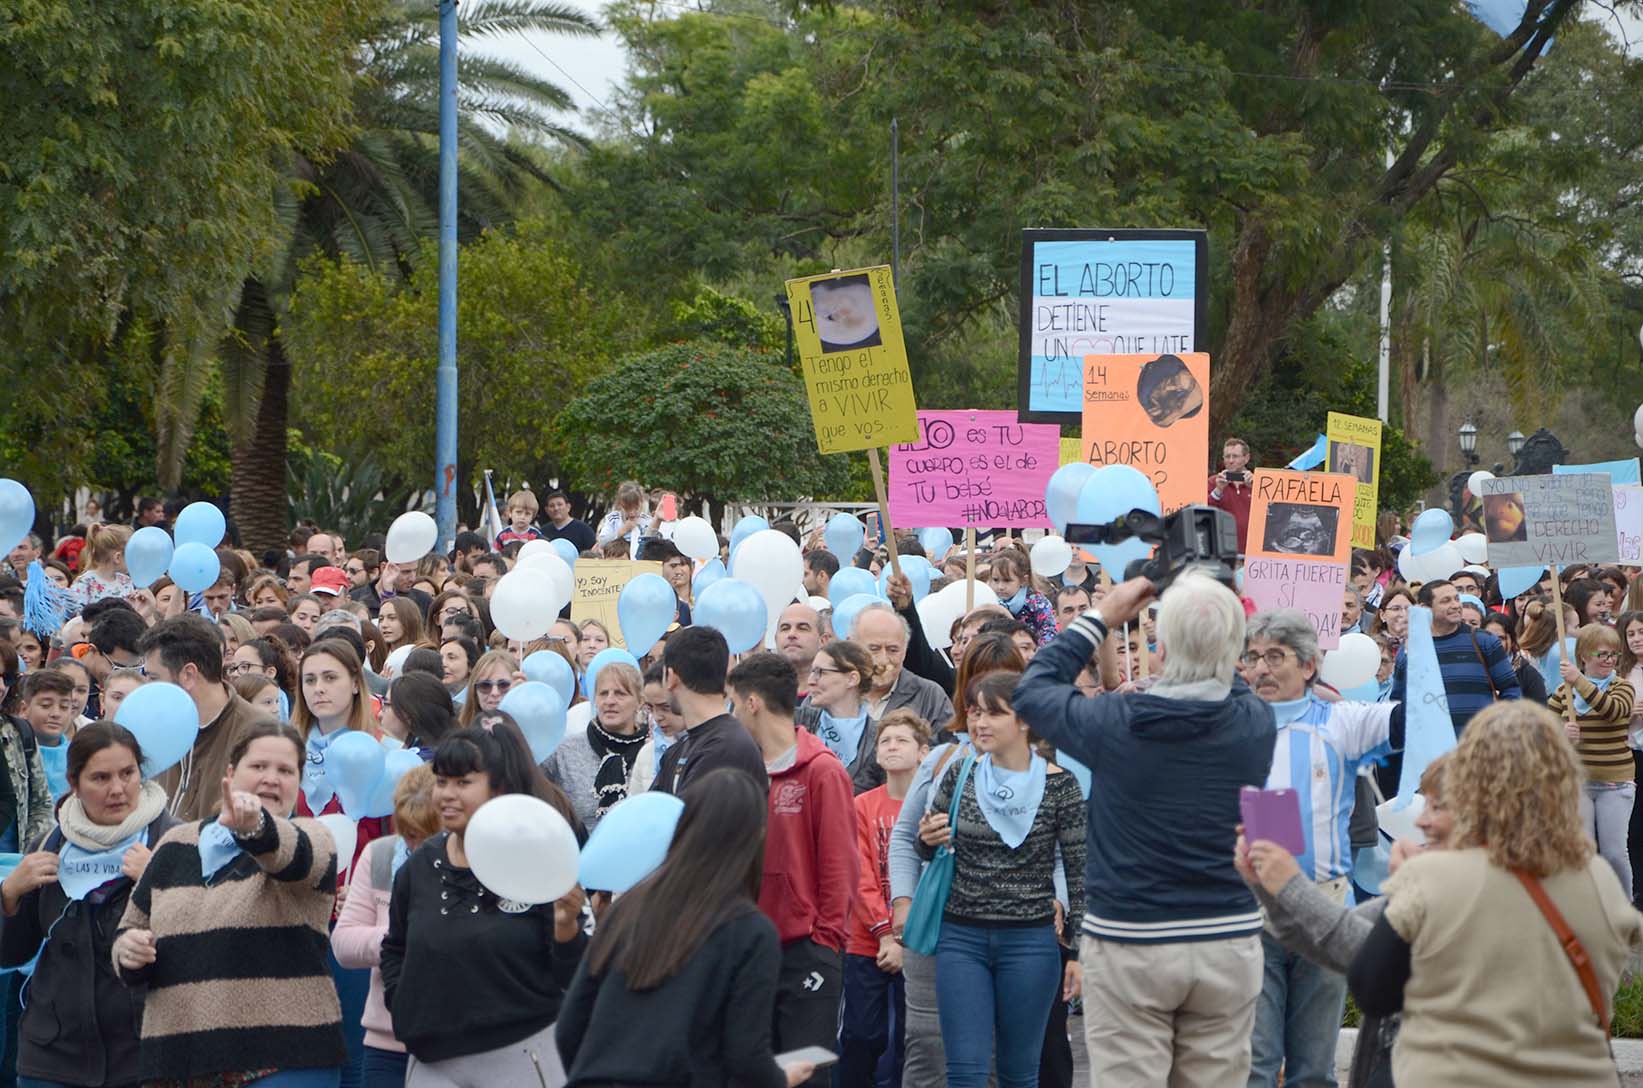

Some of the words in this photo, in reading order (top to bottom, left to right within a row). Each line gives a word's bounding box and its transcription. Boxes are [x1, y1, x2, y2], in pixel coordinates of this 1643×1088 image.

[1039, 263, 1069, 297] EL
[1078, 262, 1175, 297] ABORTO
[798, 299, 816, 335] 4
[1037, 302, 1110, 333] DETIENE
[1043, 336, 1069, 362] UN
[805, 355, 852, 377] Tengo
[858, 348, 873, 369] el
[815, 377, 859, 394] mismo
[861, 367, 909, 389] derecho
[1086, 365, 1107, 386] 14
[818, 399, 828, 413] a
[833, 388, 894, 417] VIVIR
[821, 423, 847, 445] que
[966, 428, 987, 444] es
[992, 424, 1024, 446] TU
[1015, 452, 1038, 471] de
[1089, 440, 1167, 465] ABORTO
[908, 480, 936, 504] TU
[944, 475, 993, 500] bebé
[1257, 475, 1342, 503] RAFAELA
[1534, 518, 1600, 538] DERECHO
[1534, 539, 1589, 562] VIVIR
[1294, 562, 1345, 585] FUERTE
[75, 863, 91, 873] LAS
[93, 864, 100, 873] 2
[102, 863, 121, 874] VIDA
